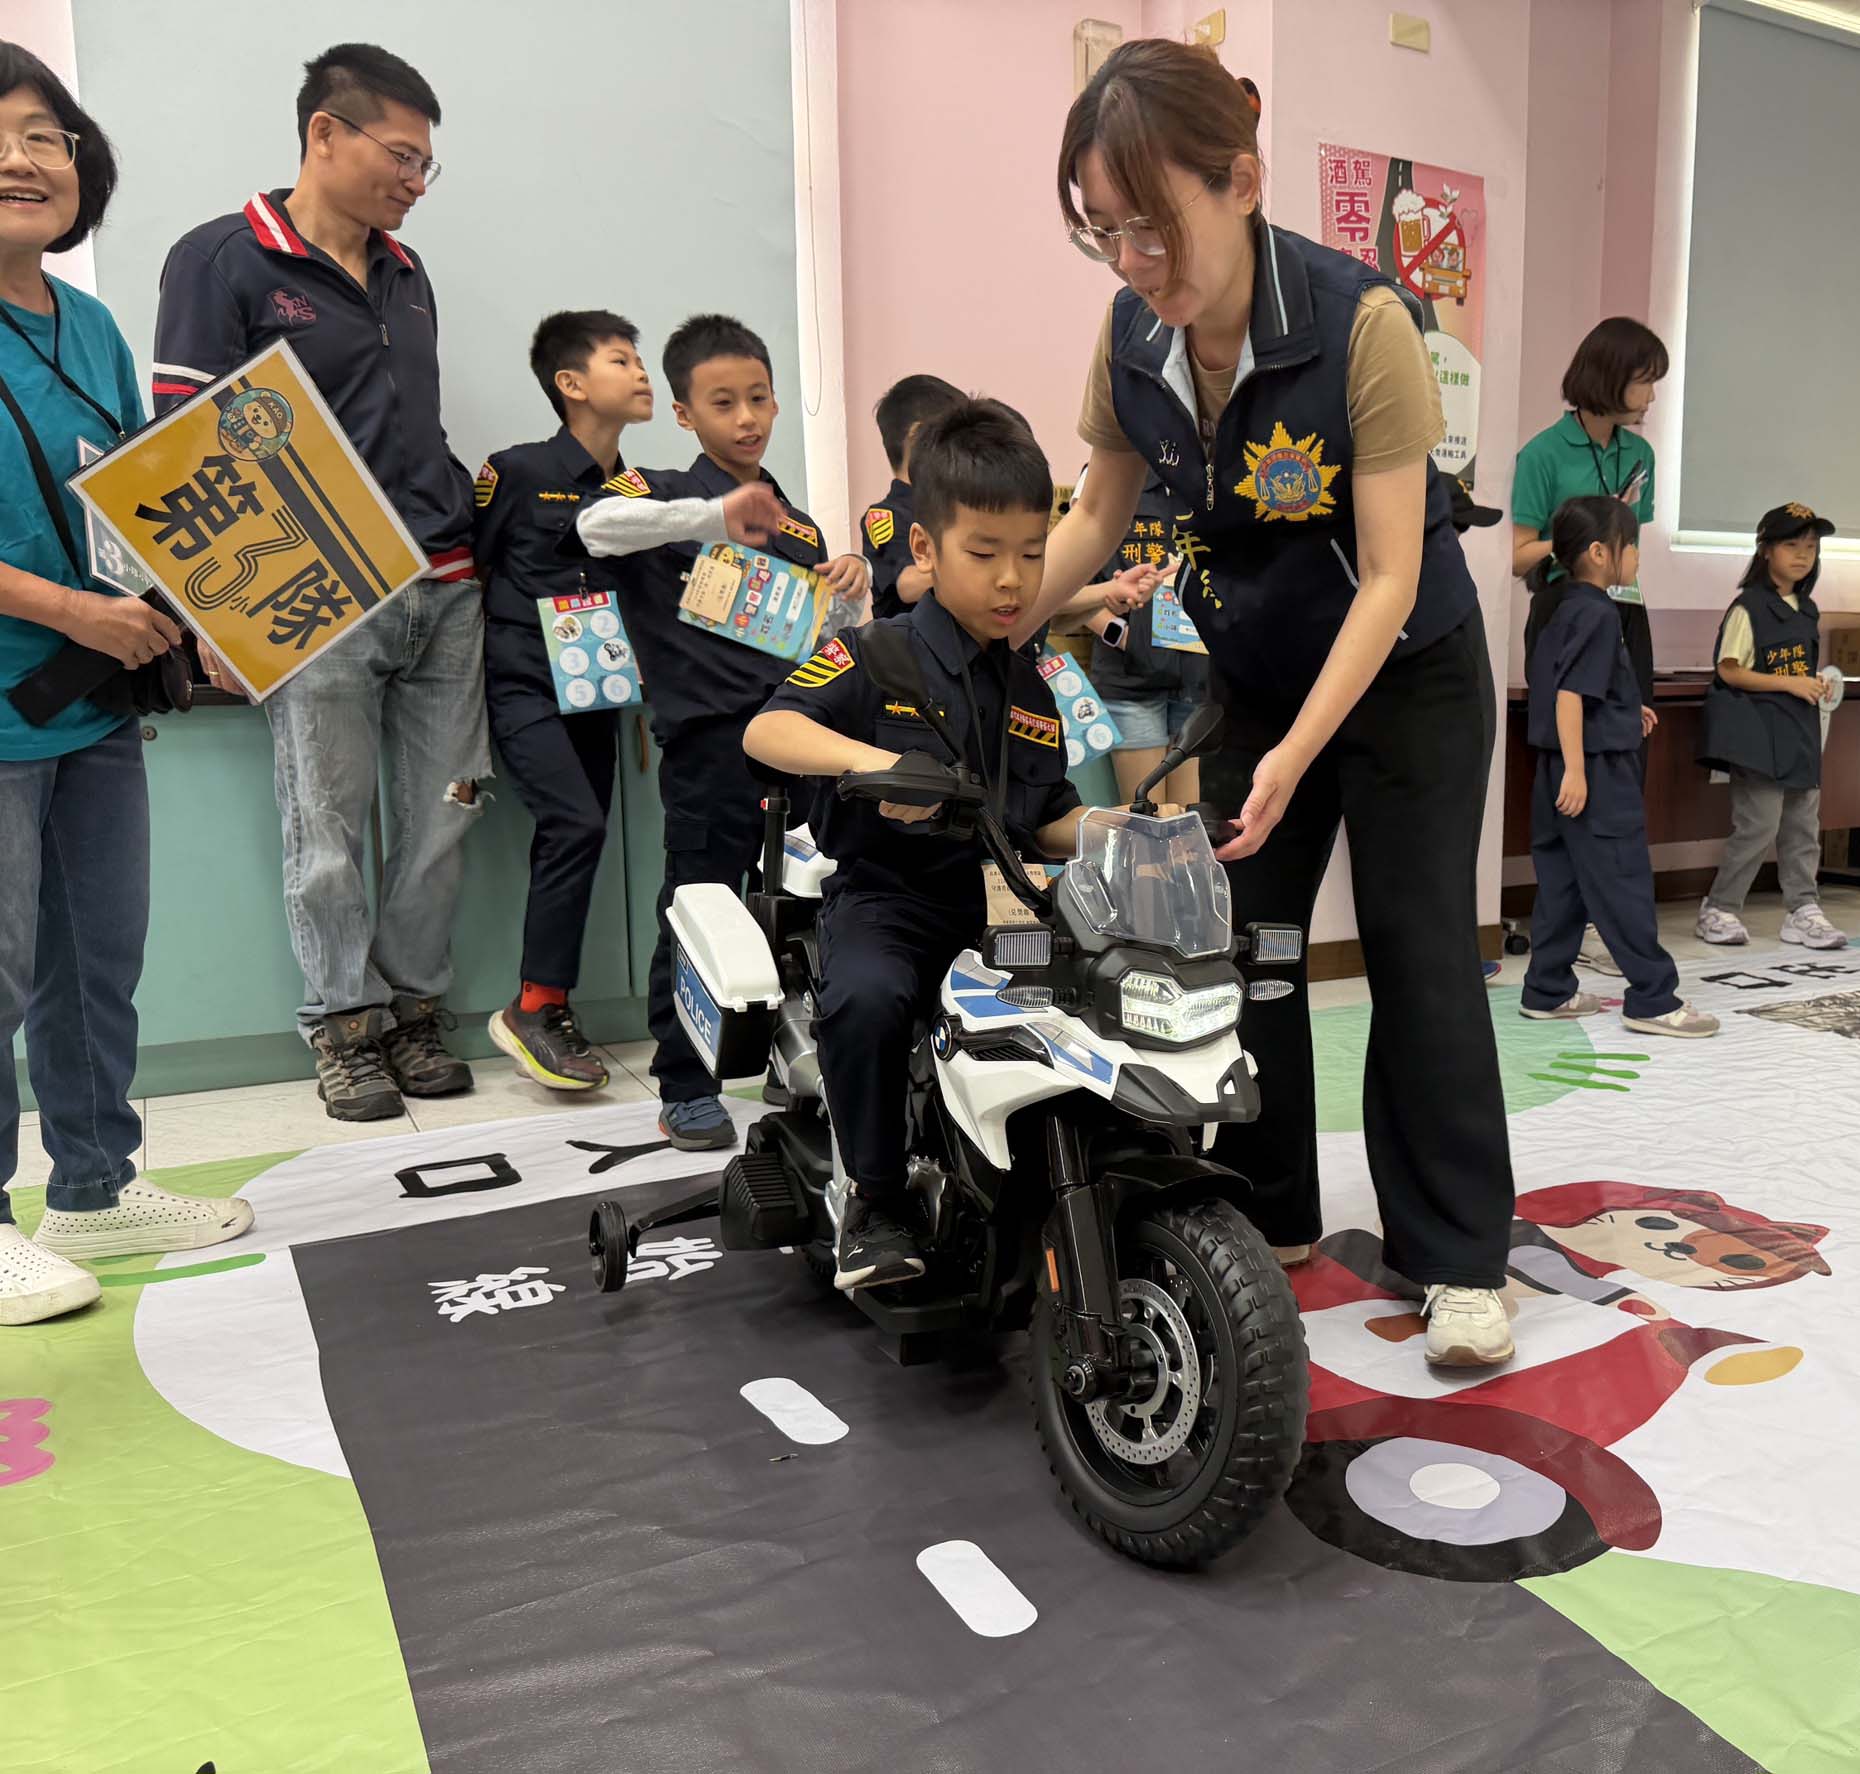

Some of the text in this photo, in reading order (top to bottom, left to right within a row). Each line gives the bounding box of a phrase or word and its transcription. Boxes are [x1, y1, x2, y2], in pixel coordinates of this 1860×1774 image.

[1328, 159, 1372, 186] 酒駕
[1335, 191, 1370, 242] 零
[1128, 520, 1165, 538] 年隊
[1121, 543, 1166, 566] 刑警
[1767, 644, 1806, 666] 少年隊
[681, 976, 712, 1044] POLICE
